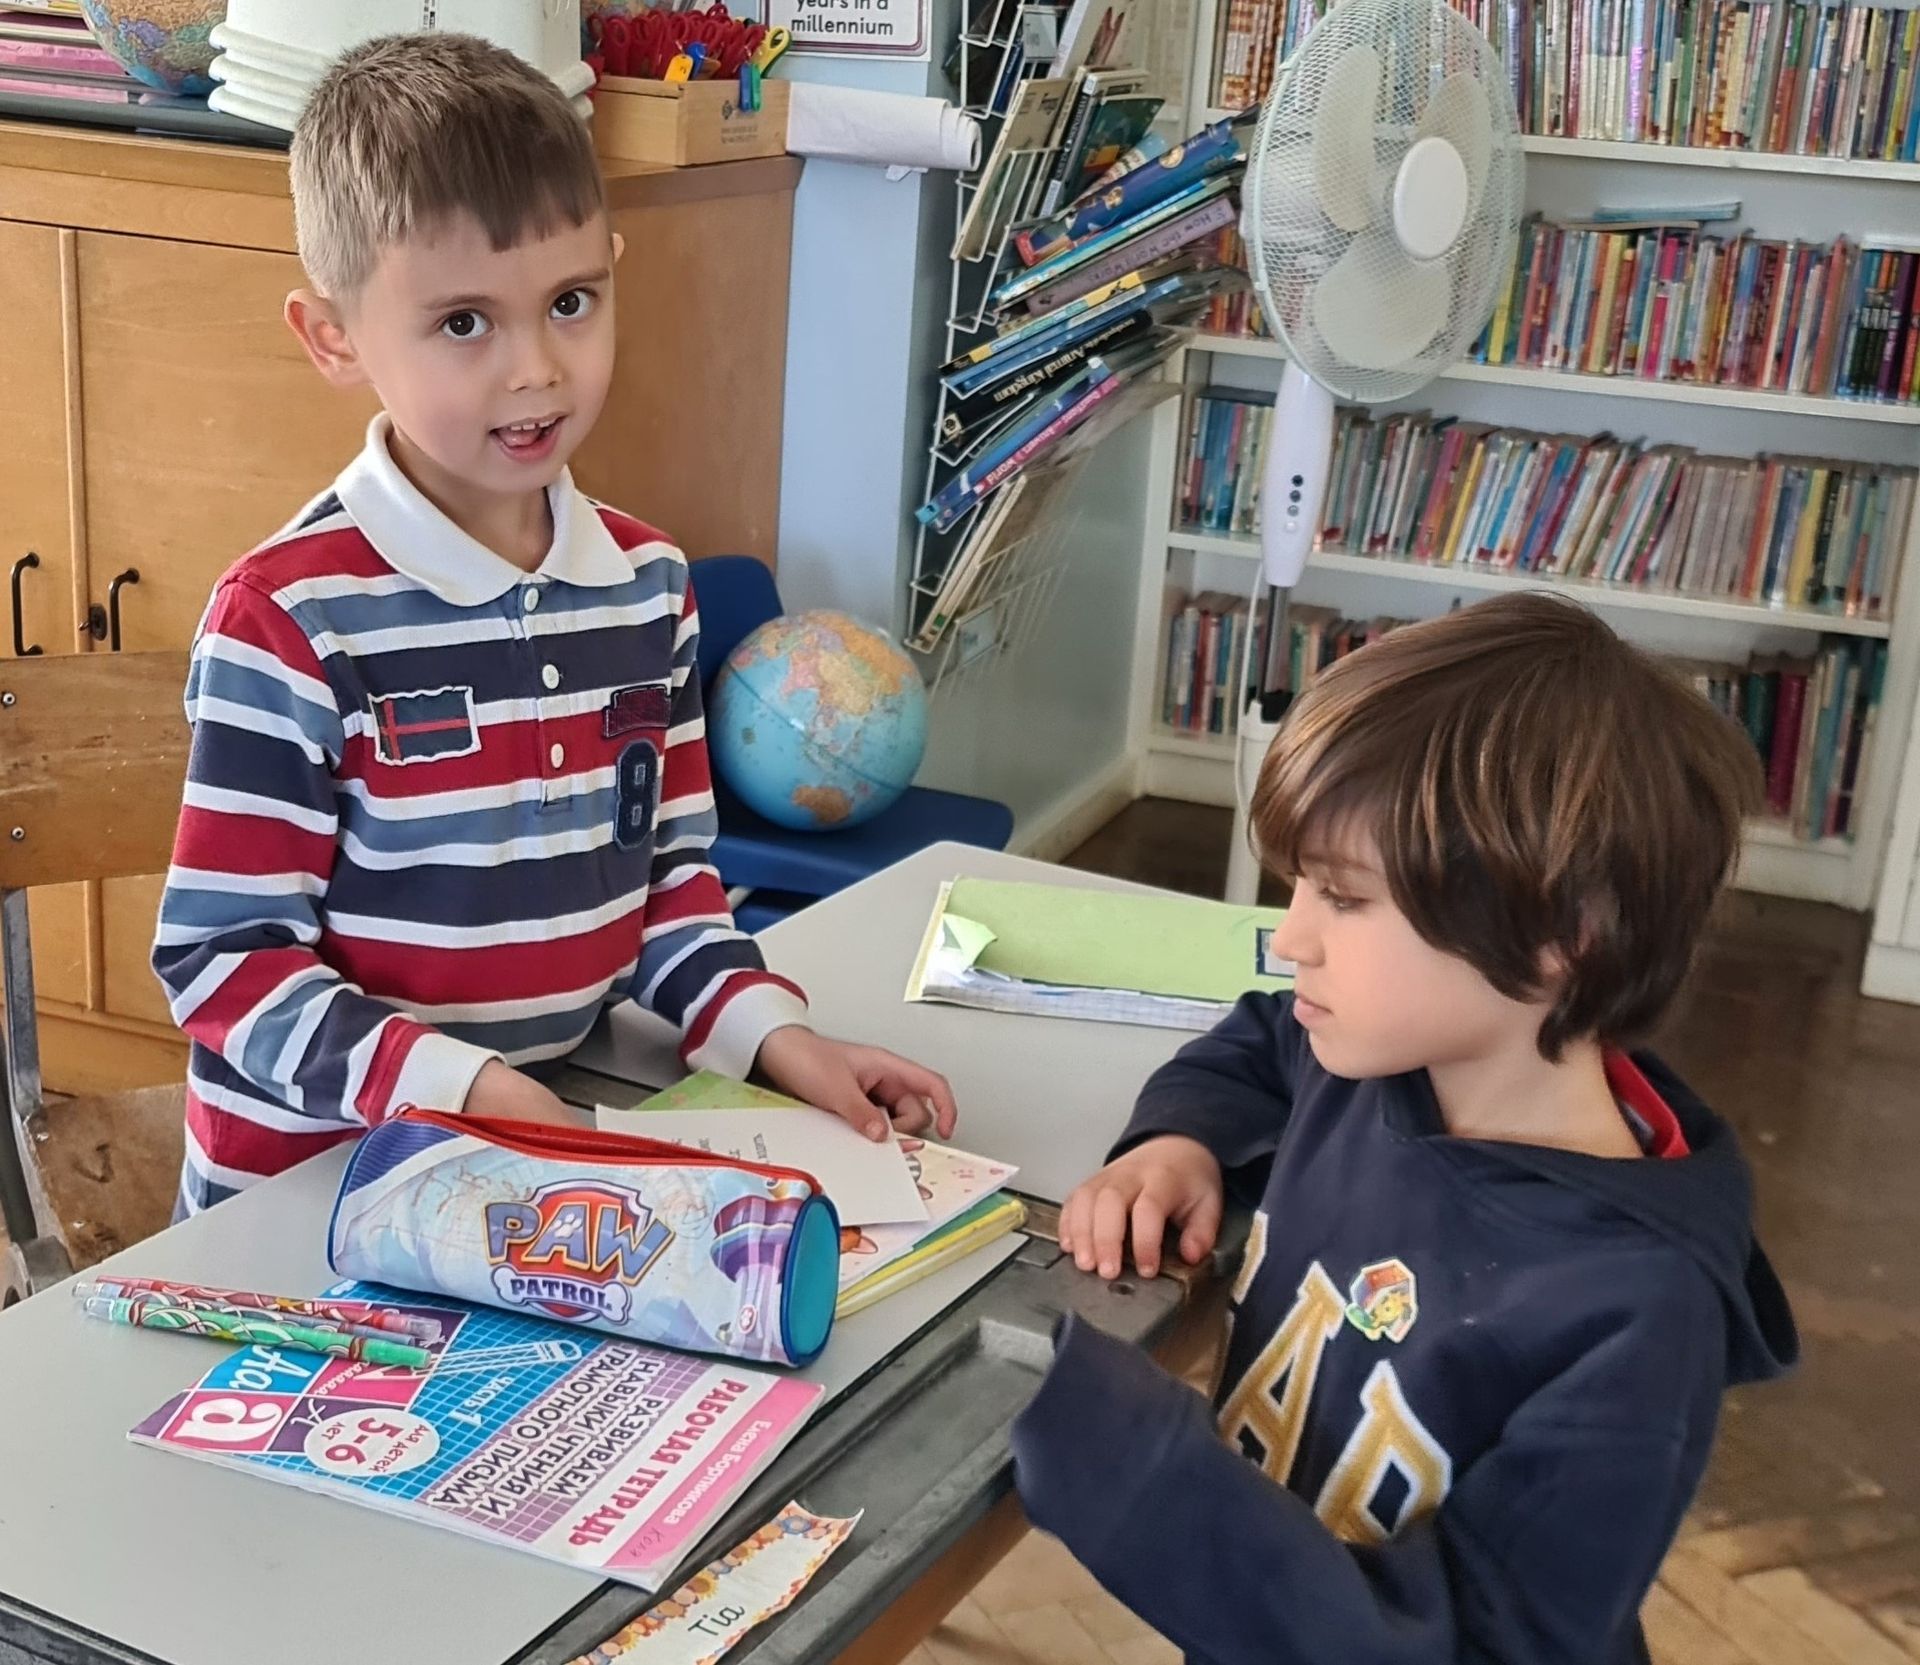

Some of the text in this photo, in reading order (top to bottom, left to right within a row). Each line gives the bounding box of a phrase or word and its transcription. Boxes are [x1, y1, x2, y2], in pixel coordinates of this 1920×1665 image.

[791, 14, 894, 36] millennium
[797, 0, 888, 12] years in a
[993, 369, 1047, 402] Kingdom
[1045, 346, 1087, 378] Animal
[483, 1201, 676, 1287] PAW
[511, 1278, 613, 1311] PATROL
[1217, 1210, 1453, 1545] AP
[325, 1417, 404, 1465] 5-6
[432, 1347, 635, 1506] ГРАМОТНОГО ПИСЬМА
[448, 1409, 484, 1426] 1
[478, 1360, 662, 1519] НАВЫКИ ЧТЕНИЯ И
[547, 1396, 663, 1498] РАЗВИВАЕМ
[568, 1377, 750, 1547] РАБОЧАЯ ТЕТРАДЬ
[663, 1420, 772, 1526] Елена Бортникова
[687, 1605, 745, 1636] Tia
